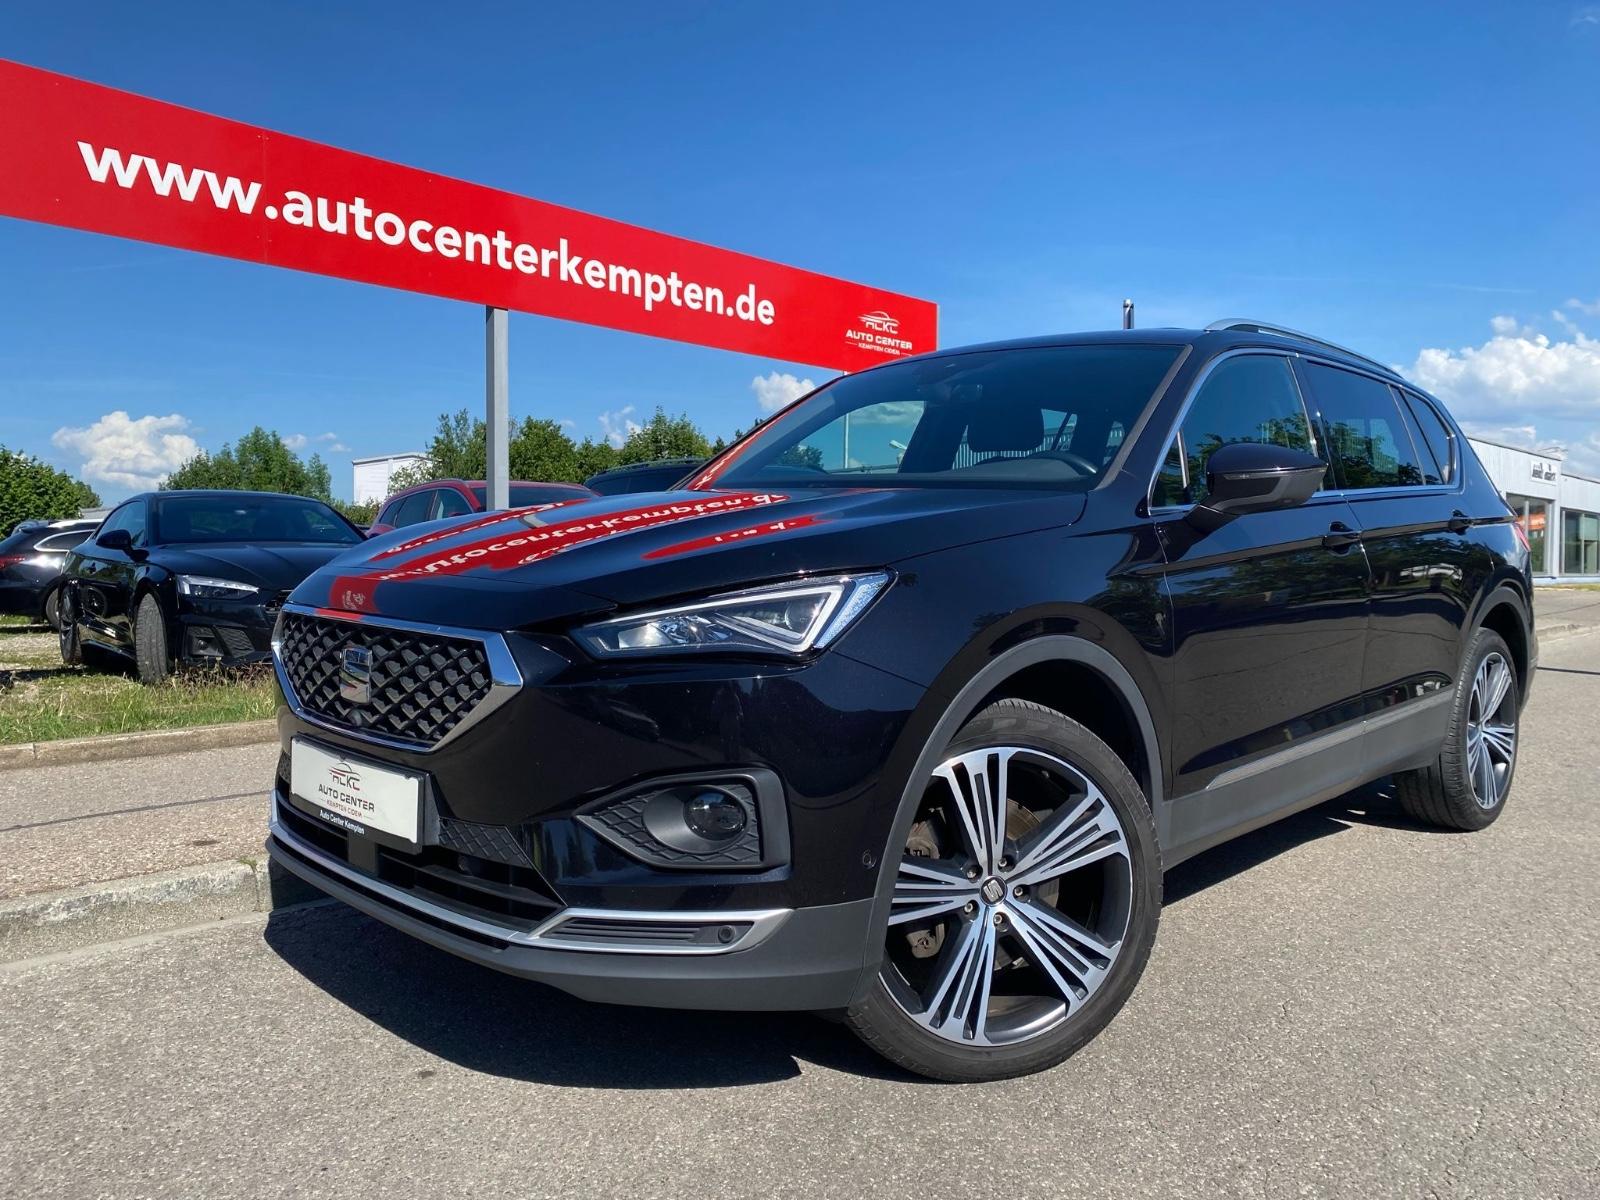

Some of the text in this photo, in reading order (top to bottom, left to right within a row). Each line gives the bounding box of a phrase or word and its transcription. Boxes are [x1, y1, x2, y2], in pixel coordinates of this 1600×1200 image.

[77, 141, 775, 326] www.autocenterkempten.de
[845, 330, 913, 350] AUTO CENTER
[319, 784, 375, 812] AUTO CENTER
[320, 810, 364, 835] Auto Center Kempten
